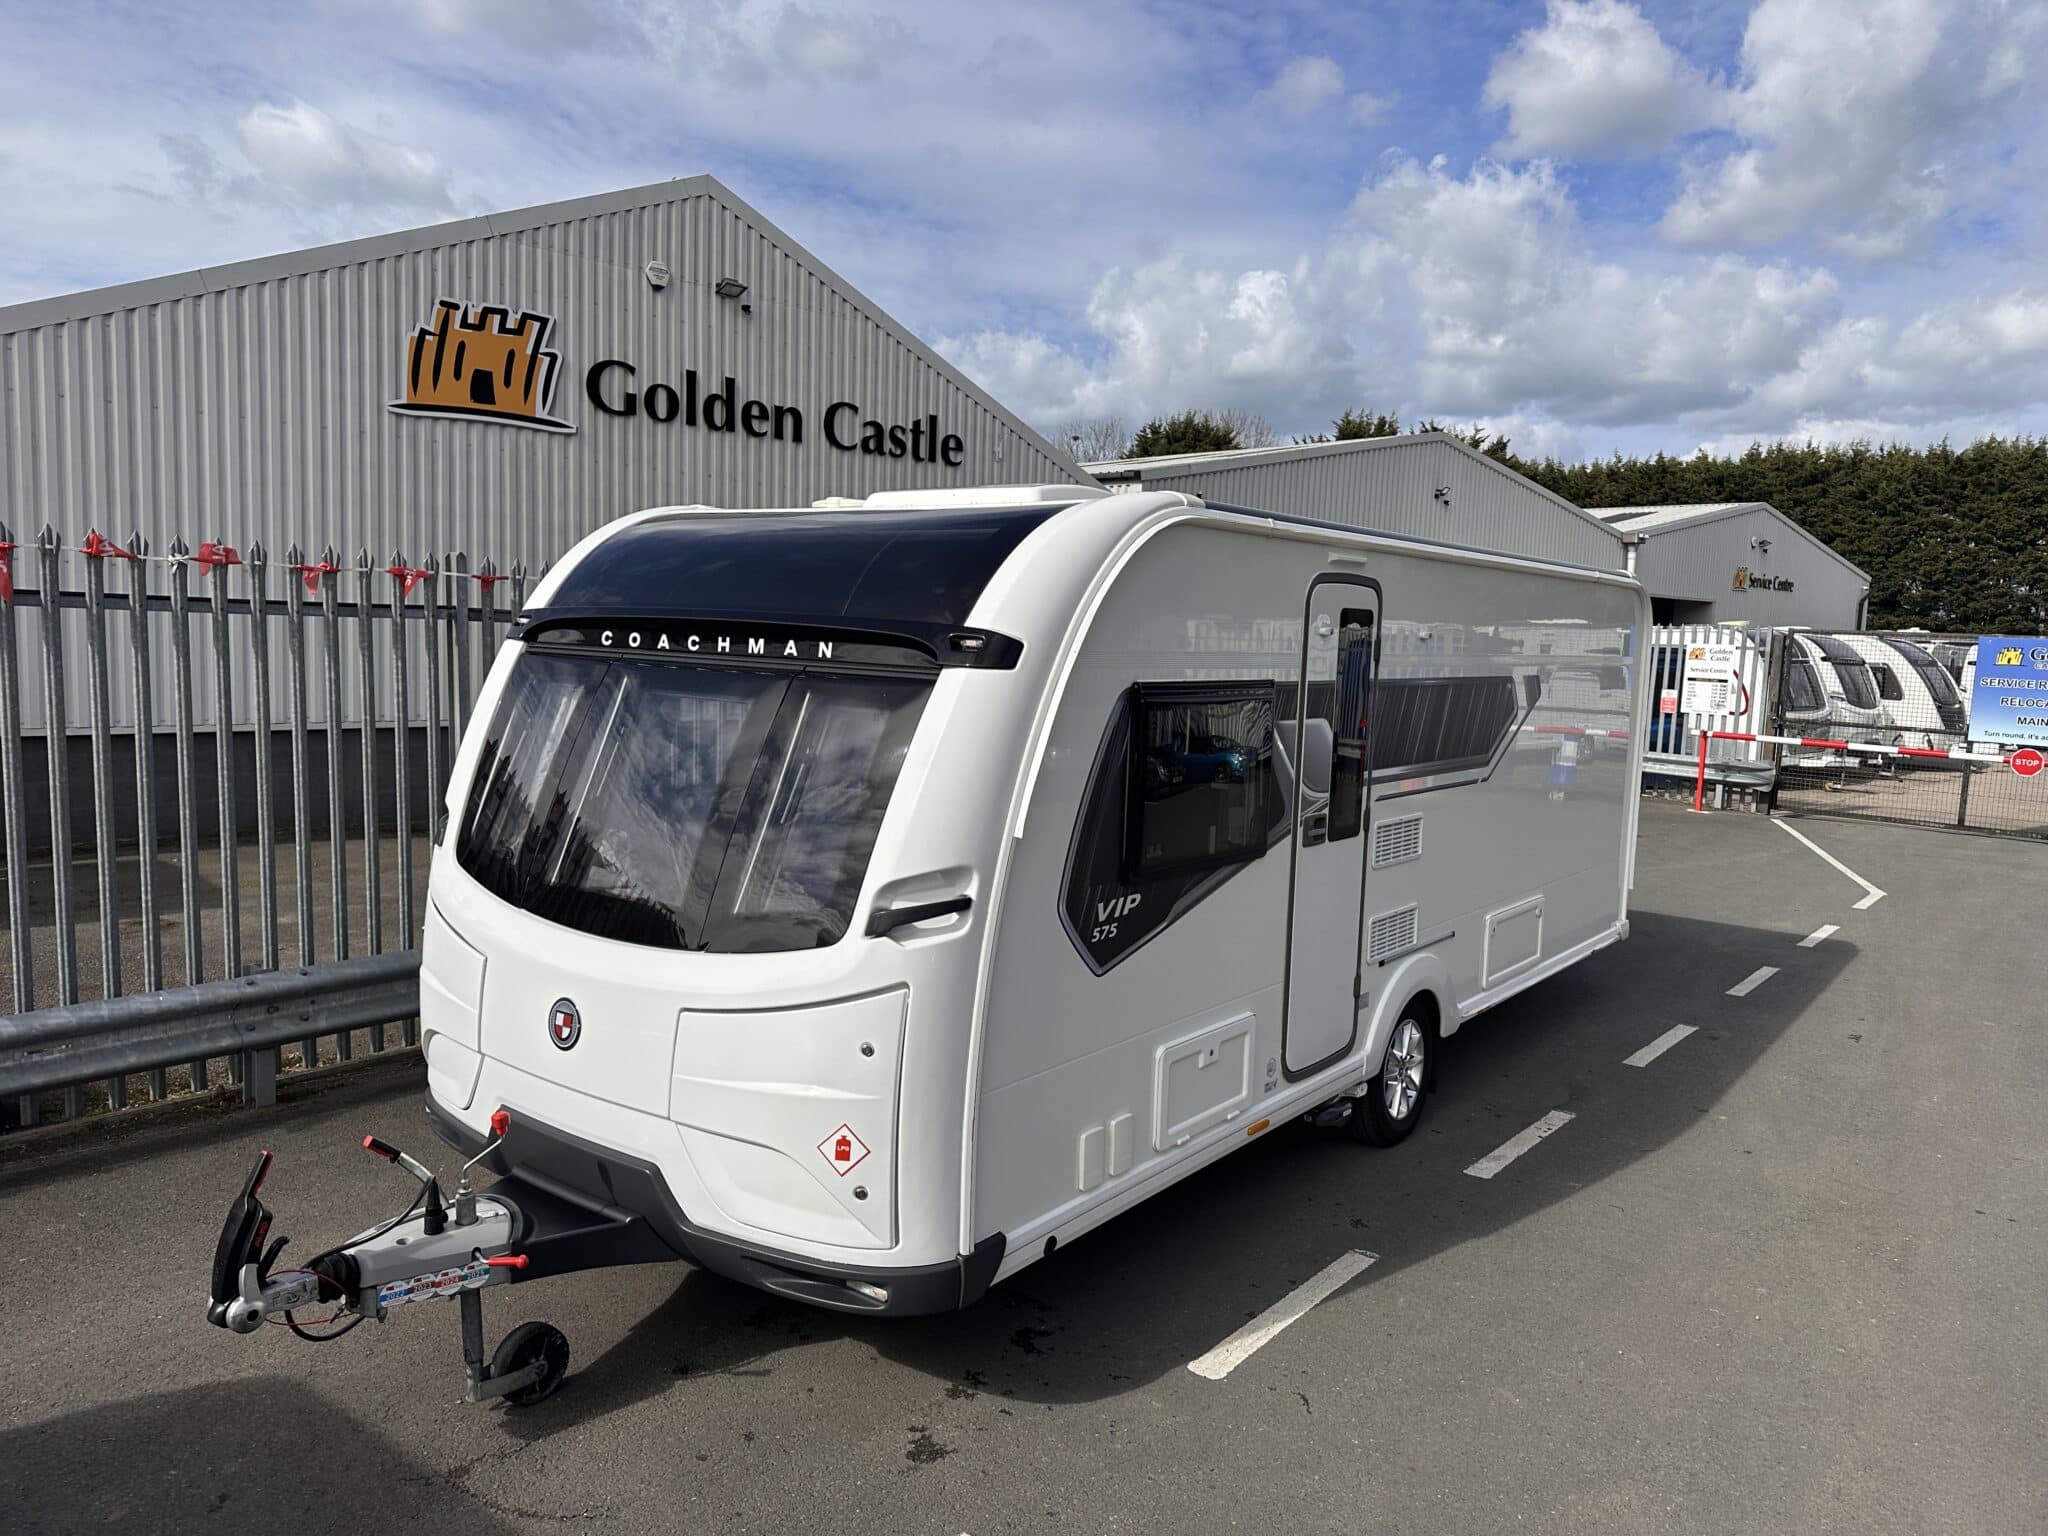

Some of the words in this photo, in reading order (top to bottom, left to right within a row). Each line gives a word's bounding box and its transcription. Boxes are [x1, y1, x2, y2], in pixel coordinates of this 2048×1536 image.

[586, 359, 803, 444] Golden
[823, 401, 964, 467] Castle
[1748, 572, 1772, 590] Service
[1773, 576, 1794, 592] Centre
[601, 630, 833, 658] COACHMAN
[1981, 678, 2034, 688] SERVICE
[2017, 717, 2048, 726] MAIN
[2002, 732, 2025, 740] round,
[2016, 759, 2039, 767] STOP
[1098, 894, 1141, 922] VIP
[1091, 922, 1118, 942] 575
